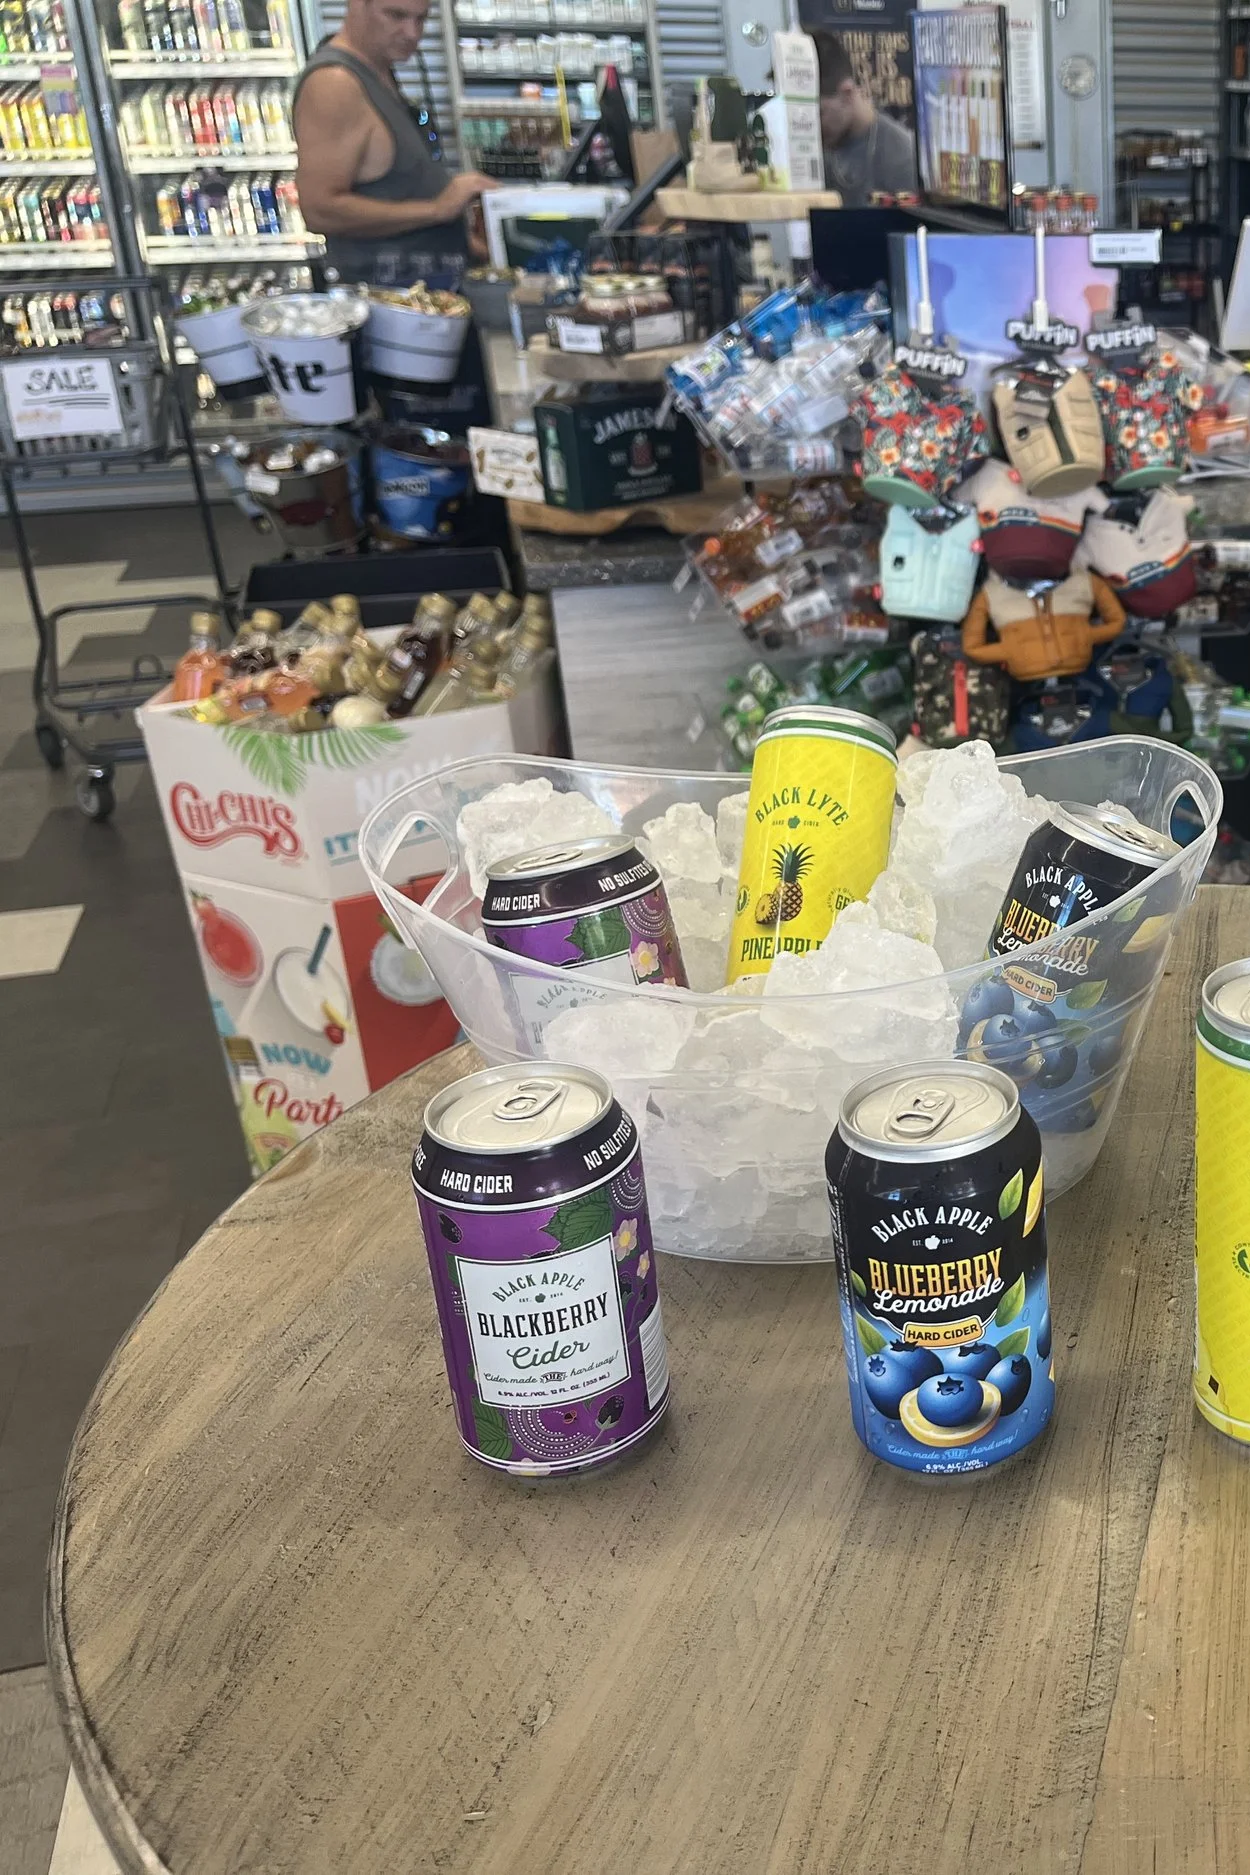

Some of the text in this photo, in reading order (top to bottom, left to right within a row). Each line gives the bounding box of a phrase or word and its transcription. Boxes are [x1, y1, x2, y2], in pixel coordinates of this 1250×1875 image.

[25, 364, 99, 394] SALE
[755, 786, 850, 827] BLACK LYTE
[598, 861, 648, 893] NO SULFITES
[1025, 865, 1104, 920] BLACK APPL
[492, 893, 541, 912] HARD CIDER
[1025, 978, 1053, 997] CIDER
[261, 1042, 332, 1076] NOW
[583, 1120, 632, 1171] NO SULFITES
[440, 1168, 513, 1194] HARD CIDER
[871, 1205, 994, 1243] BLACK APPLE
[912, 1239, 924, 1247] EST.
[492, 1274, 536, 1303] BLACK
[541, 1271, 585, 1292] APPLE
[868, 1247, 1002, 1297] BLUEBERRY
[872, 1273, 1005, 1315] Lemonade
[476, 1291, 608, 1338] BLACKBERRY
[907, 1323, 978, 1341] HARD CIDER
[483, 1349, 619, 1384] Cider made THE hard way!
[506, 1340, 590, 1370] Cider
[913, 1451, 940, 1460] made
[971, 1443, 995, 1456] hard
